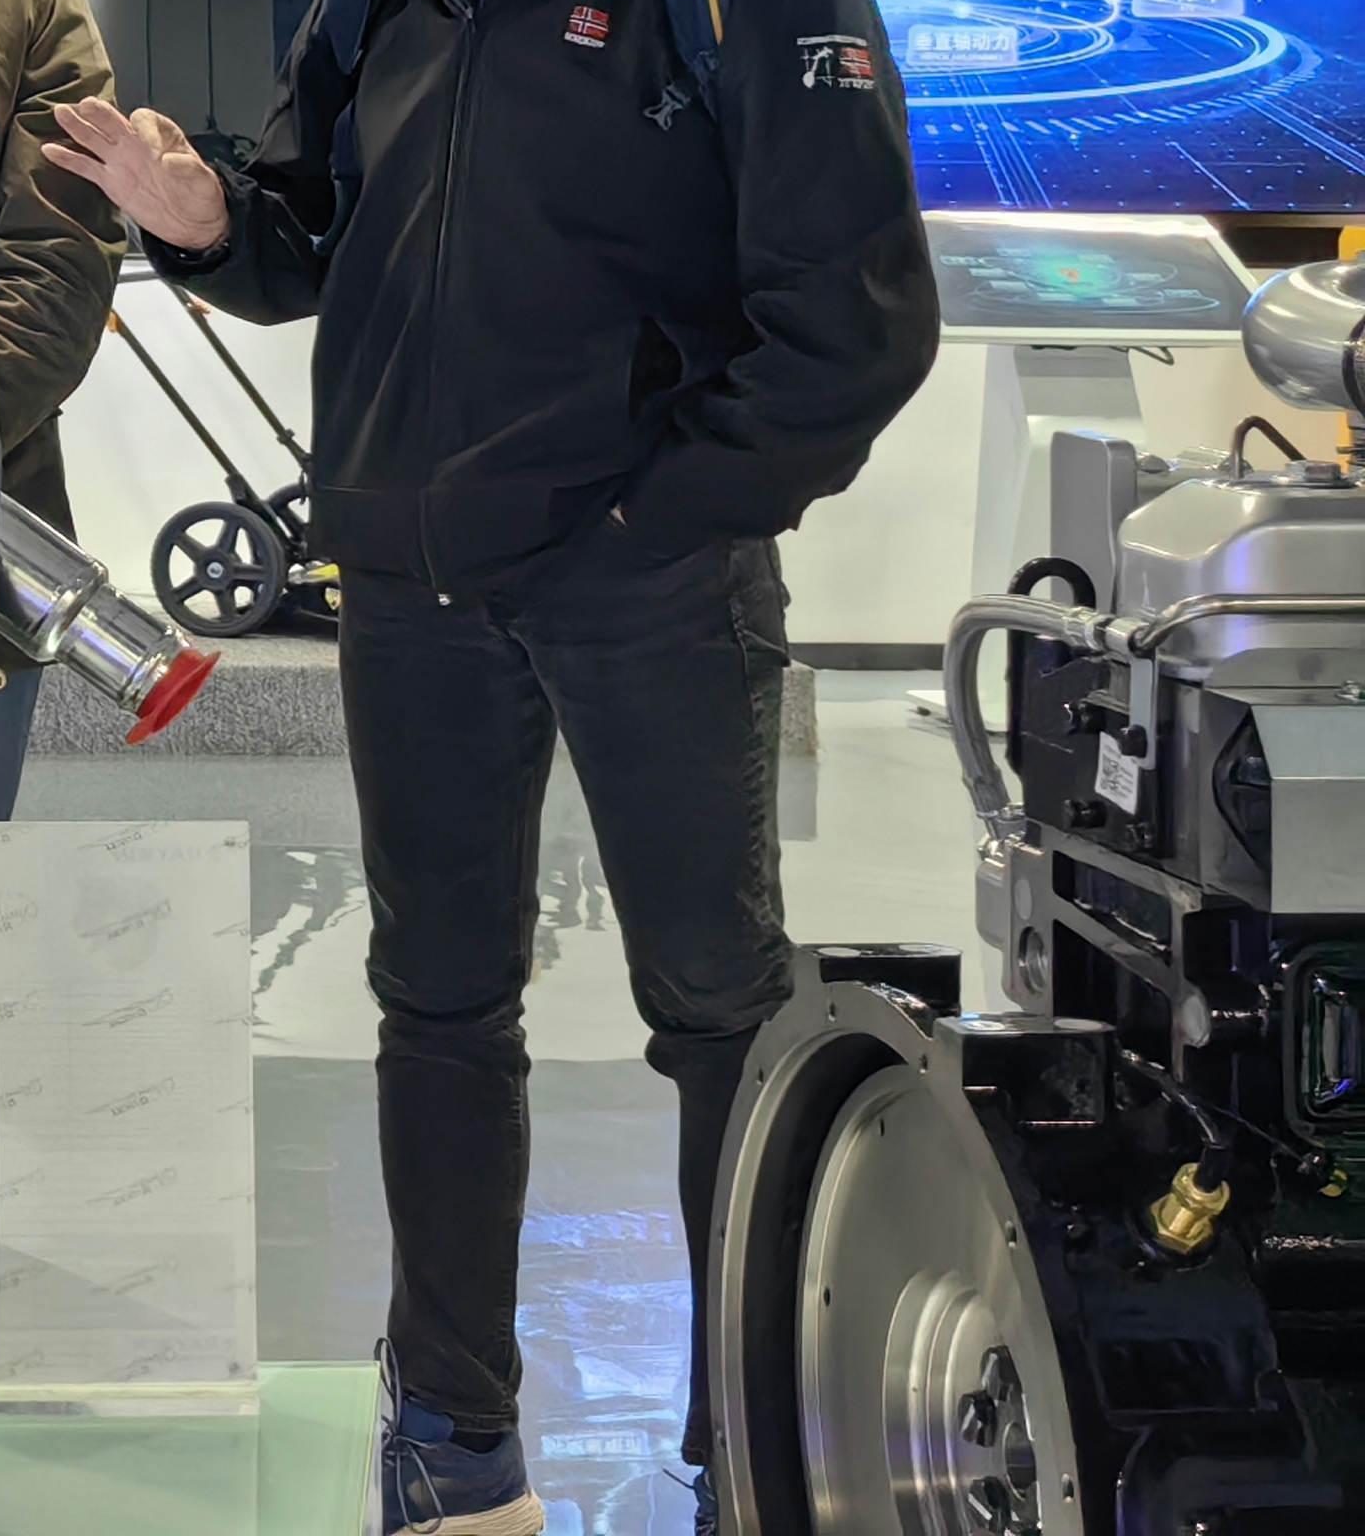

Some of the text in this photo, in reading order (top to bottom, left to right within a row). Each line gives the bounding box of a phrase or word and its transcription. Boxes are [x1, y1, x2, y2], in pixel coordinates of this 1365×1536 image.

[915, 30, 1010, 52] 垂直轴动力
